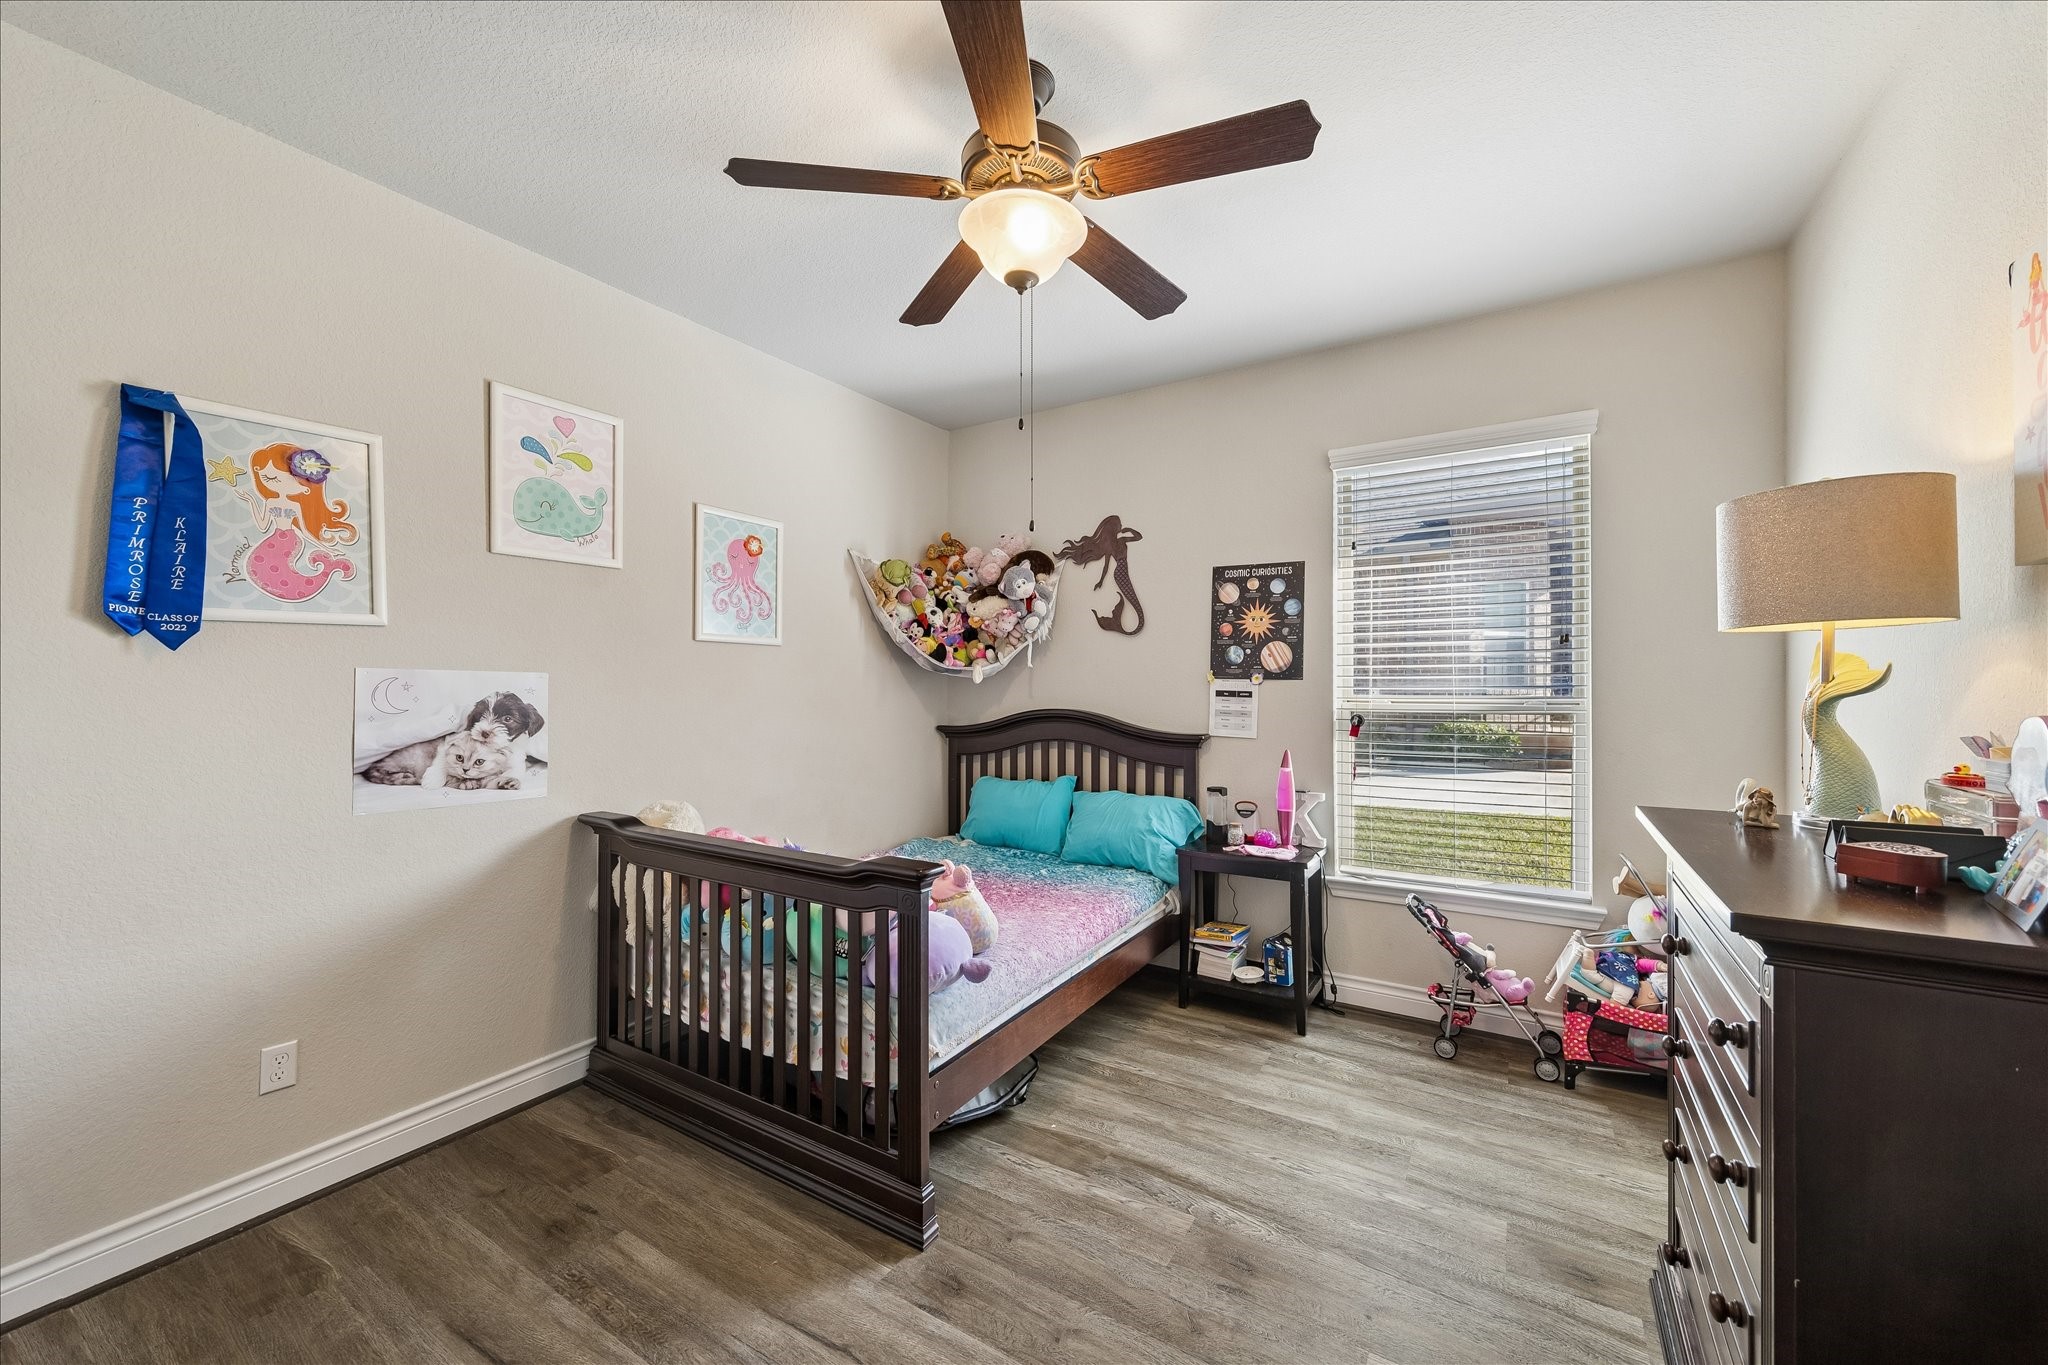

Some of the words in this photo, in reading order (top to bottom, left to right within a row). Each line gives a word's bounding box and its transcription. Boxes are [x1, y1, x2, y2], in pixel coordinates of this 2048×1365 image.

[127, 497, 148, 602] PRIMROSE
[170, 517, 187, 591] KLAIRE
[222, 536, 253, 585] Mermaid
[1224, 568, 1250, 578] COSMIC
[1251, 566, 1293, 577] CURIOSITIES
[147, 613, 183, 622] CLASS
[184, 614, 200, 623] OF
[160, 623, 187, 632] 2022
